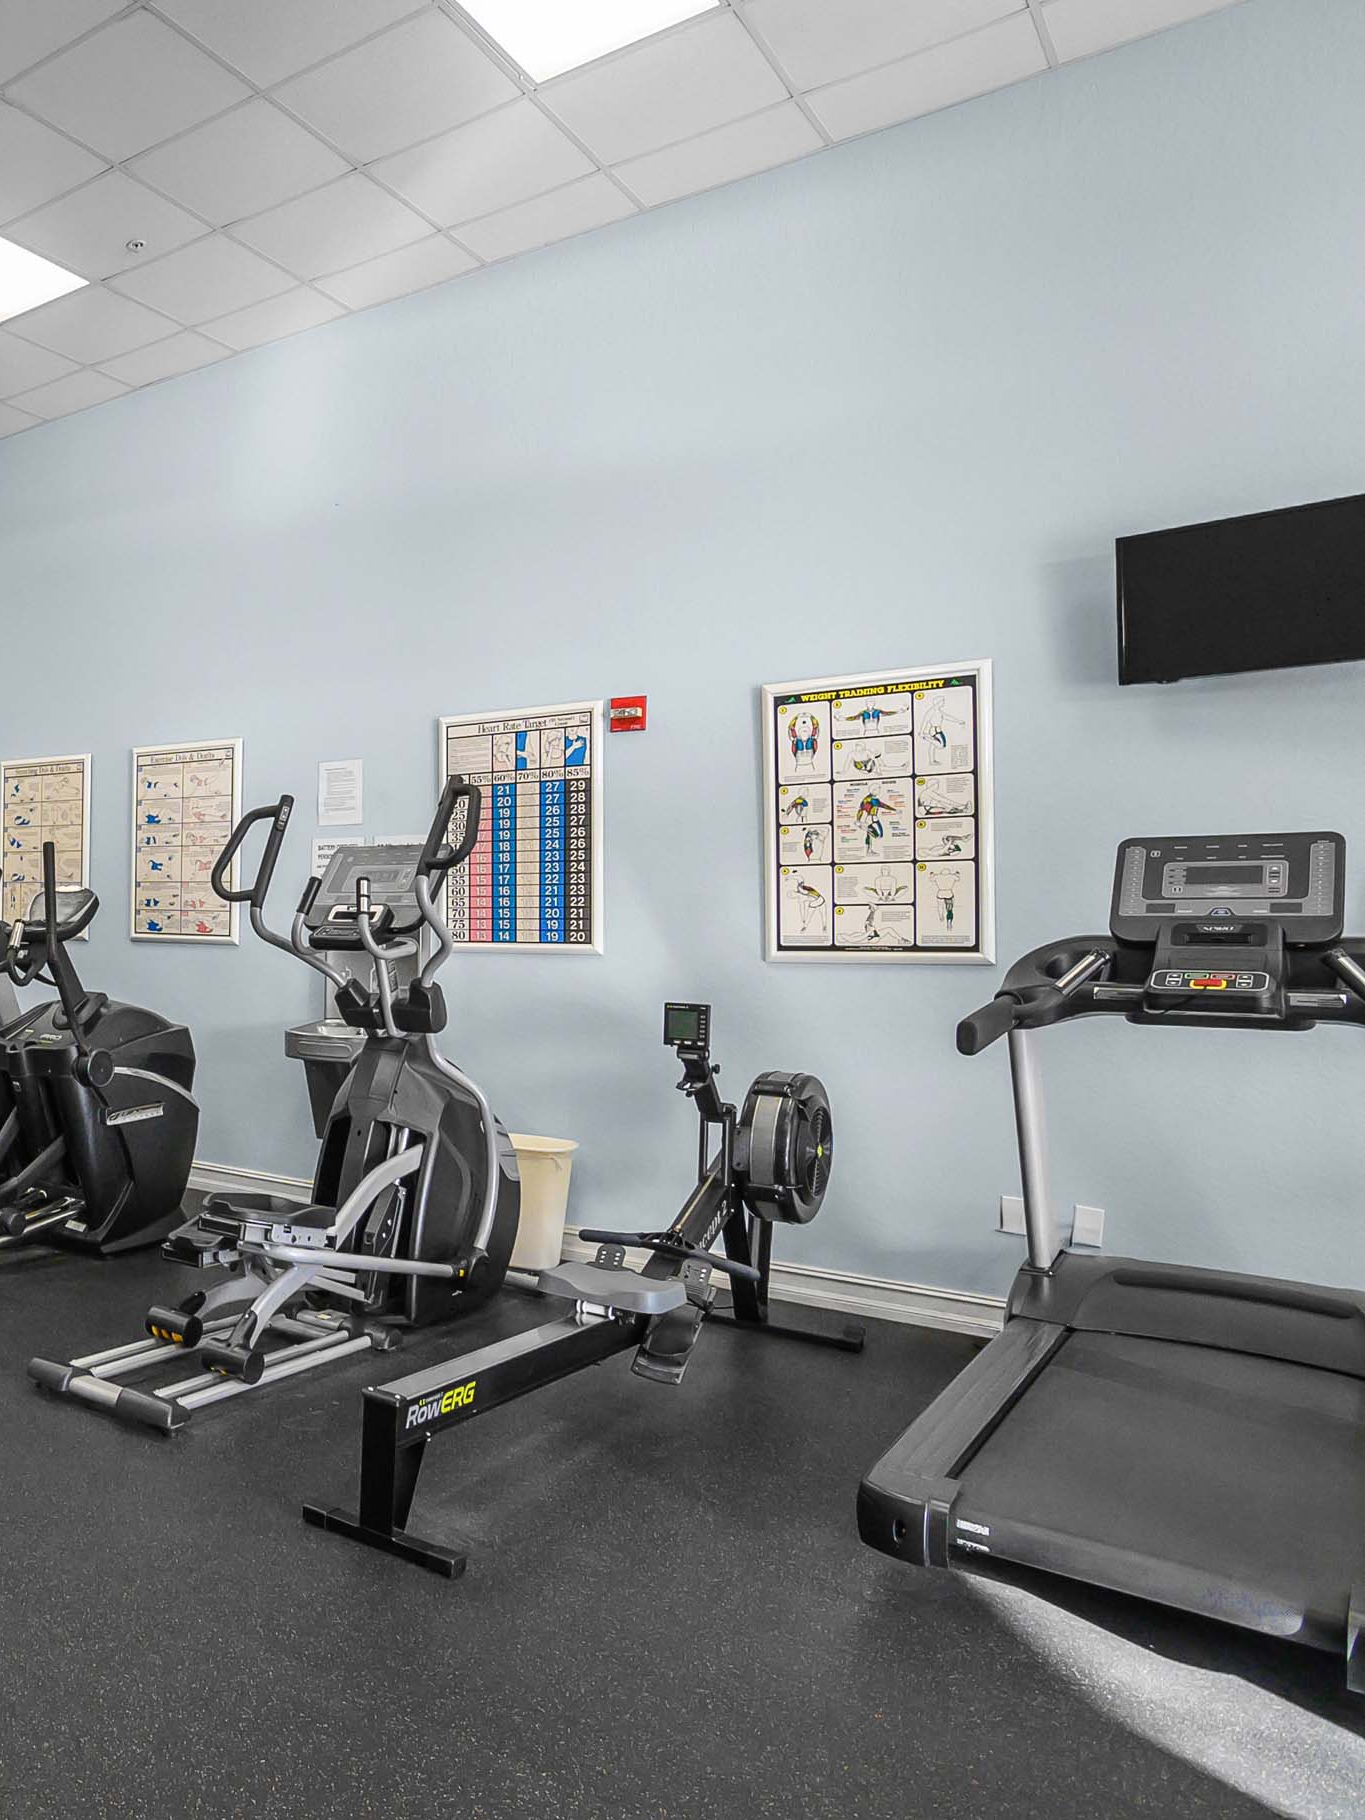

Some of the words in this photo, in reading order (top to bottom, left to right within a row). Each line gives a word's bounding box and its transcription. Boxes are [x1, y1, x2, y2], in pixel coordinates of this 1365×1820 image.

[801, 692, 837, 702] WEIGHT
[839, 686, 885, 698] TRAINING
[887, 680, 945, 693] FLEXIBILITY
[478, 724, 500, 734] Heart
[503, 722, 521, 732] Rate
[523, 719, 547, 730] Target
[471, 775, 491, 784] 55%
[494, 773, 515, 782] 60%
[518, 771, 539, 780] 70%
[542, 770, 563, 778] 80%
[567, 767, 589, 776] 85%
[497, 786, 510, 795] 21
[545, 782, 560, 792] 27
[570, 781, 585, 790] 29
[497, 798, 511, 806] 20
[545, 794, 560, 804] 27
[570, 792, 585, 802] 28
[452, 811, 465, 820] 25
[498, 808, 510, 818] 19
[545, 806, 560, 815] 26
[570, 804, 585, 814] 28
[452, 822, 465, 831] 30
[498, 820, 510, 829] 19
[545, 817, 560, 827] 25
[570, 816, 585, 825] 27
[498, 831, 510, 840] 19
[545, 828, 560, 838] 25
[570, 827, 585, 837] 26
[498, 842, 510, 851] 18
[545, 840, 560, 850] 24
[570, 839, 585, 848] 26
[498, 853, 510, 862] 18
[545, 851, 560, 861] 23
[570, 850, 585, 860] 25
[498, 864, 510, 873] 17
[545, 863, 560, 872] 23
[570, 862, 585, 872] 24
[452, 876, 465, 885] 55
[498, 875, 510, 884] 17
[545, 874, 560, 883] 22
[570, 873, 585, 883] 23
[452, 887, 465, 896] 60
[498, 886, 510, 896] 16
[545, 885, 558, 895] 21
[570, 885, 585, 895] 23
[452, 898, 465, 907] 65
[498, 897, 510, 906] 16
[545, 897, 558, 906] 21
[570, 897, 585, 906] 22
[452, 909, 465, 918] 70
[498, 908, 510, 917] 15
[545, 909, 560, 918] 20
[570, 909, 583, 918] 21
[452, 920, 465, 928] 75
[498, 920, 510, 929] 15
[547, 920, 558, 929] 19
[570, 920, 583, 929] 21
[452, 931, 465, 940] 80
[498, 932, 510, 940] 14
[547, 932, 558, 941] 19
[570, 932, 585, 942] 20
